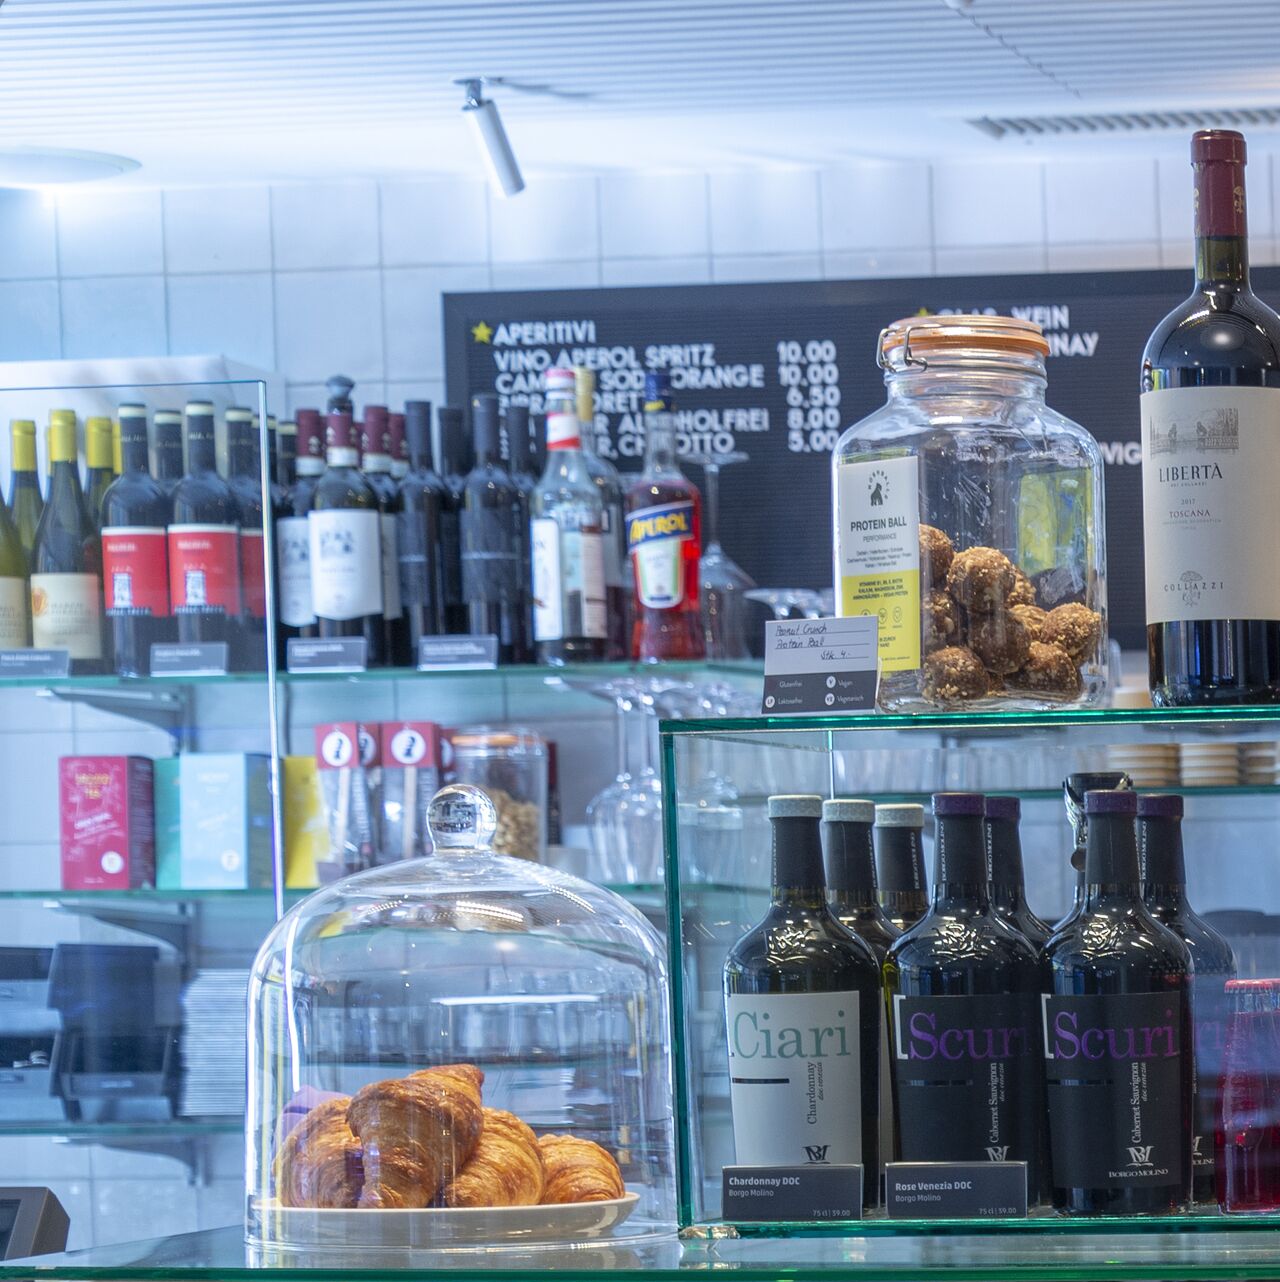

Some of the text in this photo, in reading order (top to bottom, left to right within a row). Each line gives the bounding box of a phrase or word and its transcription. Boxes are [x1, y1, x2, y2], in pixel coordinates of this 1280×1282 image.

[493, 320, 595, 345] APERITIVI
[557, 343, 715, 370] APEROL SPRITZ
[1159, 462, 1223, 483] LIBERTÀ
[851, 517, 907, 532] PROTEIN BALL
[1169, 509, 1210, 518] TOSCANA
[630, 511, 689, 544] APEROL
[734, 1010, 851, 1059] Ciari
[1054, 1009, 1180, 1060] Scuri
[807, 1062, 817, 1125] Chardonnay
[1130, 1062, 1141, 1144] Cabernet Sauvignon
[729, 1177, 800, 1187] Chardonnay DOC
[729, 1189, 749, 1197] Borgo
[895, 1182, 972, 1191] Rose Venezia DOC
